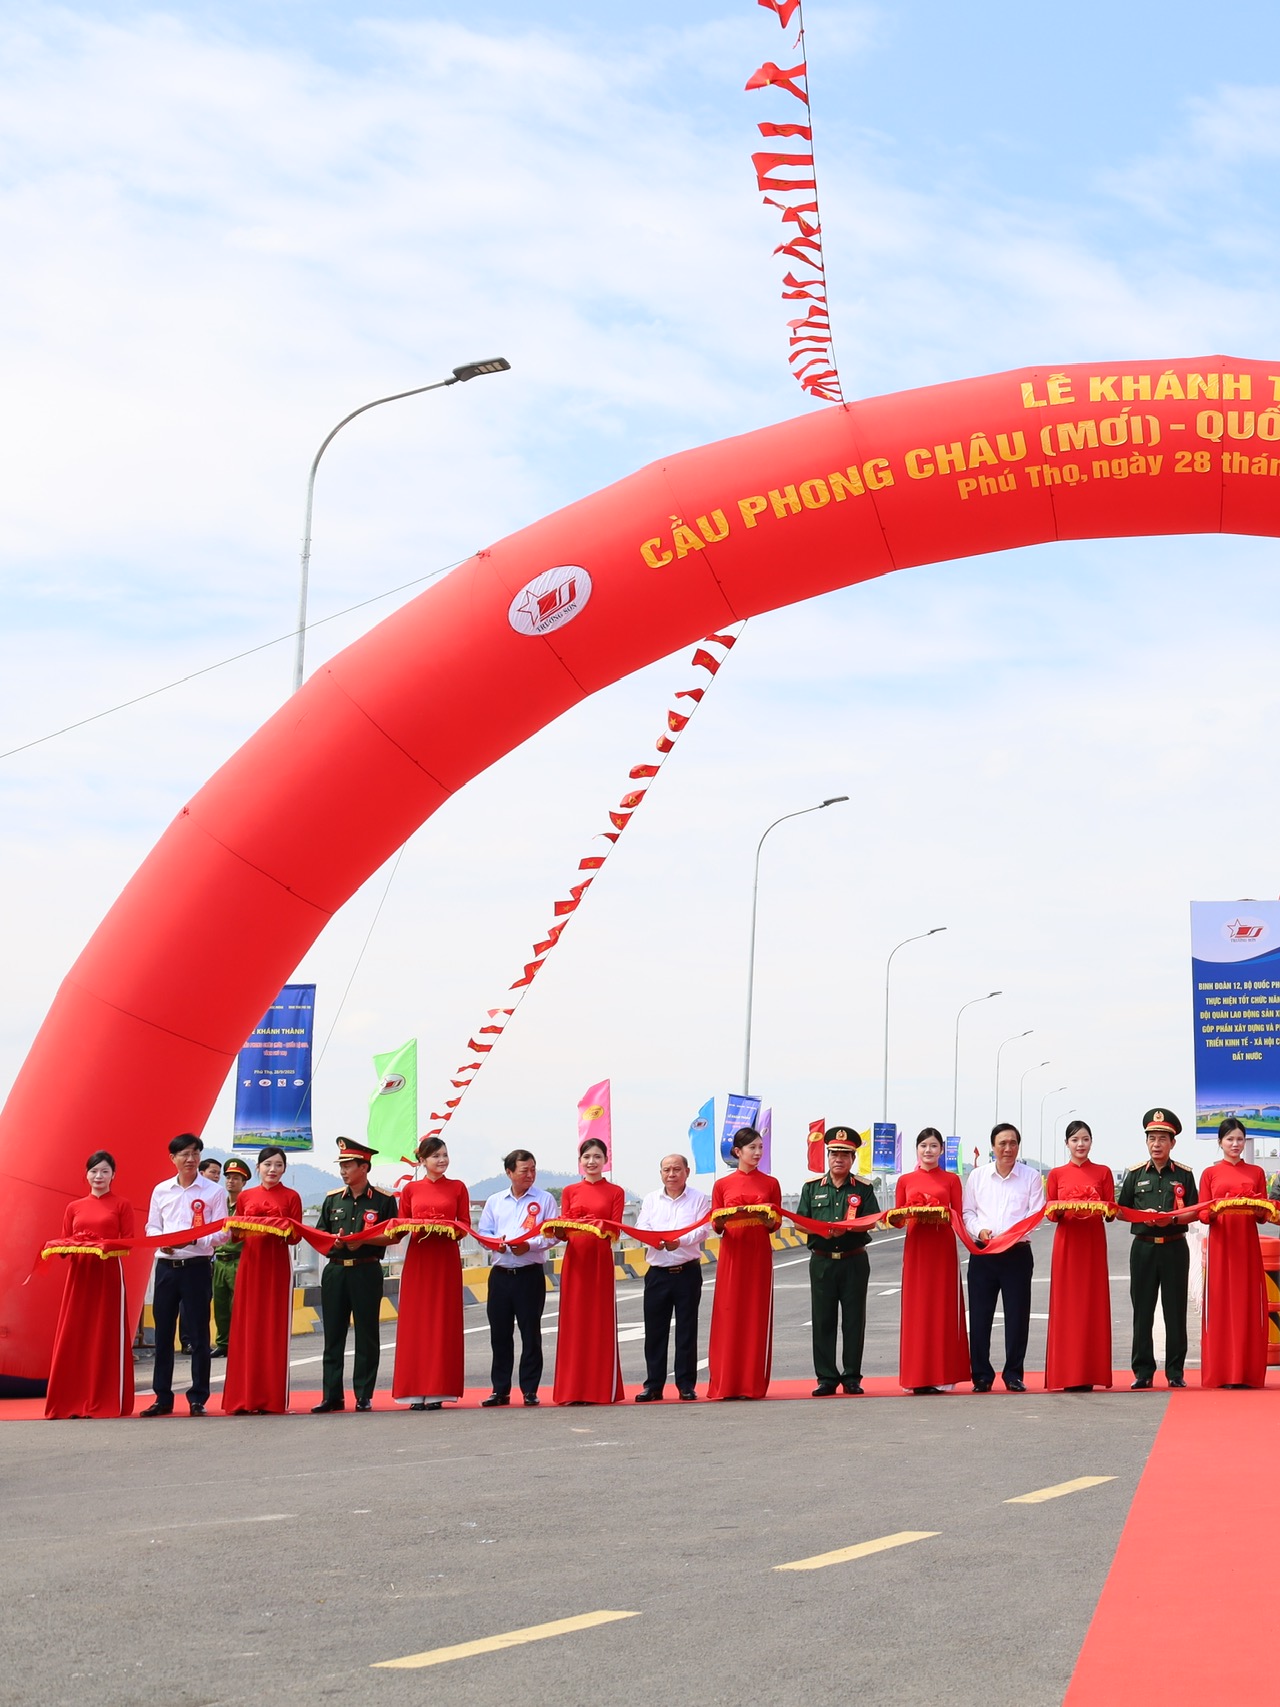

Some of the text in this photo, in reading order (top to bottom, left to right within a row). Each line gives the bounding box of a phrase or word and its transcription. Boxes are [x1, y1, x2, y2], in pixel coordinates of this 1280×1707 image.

[1020, 372, 1076, 409] LỄ
[1088, 369, 1252, 404] KHÁNH
[957, 467, 1018, 501] Phú
[1024, 463, 1089, 488] Thọ,
[1092, 450, 1164, 480] ngày
[1174, 450, 1212, 474] 28
[639, 508, 731, 570] CẦU
[737, 457, 895, 530] PHONG
[904, 430, 1027, 482] CHÂU
[1039, 406, 1161, 457] (MỚI)
[1198, 982, 1214, 990] BINH
[1233, 982, 1242, 990] 12,
[1244, 980, 1252, 990] BỘ
[1254, 979, 1270, 989] QUỐC
[1238, 993, 1249, 1004] TỐT
[1230, 1011, 1242, 1019] LAO
[1202, 1024, 1214, 1033] GÓP
[1266, 1022, 1274, 1031] VÀ
[1225, 1038, 1240, 1047] KINH
[1241, 1036, 1248, 1046] TẾ
